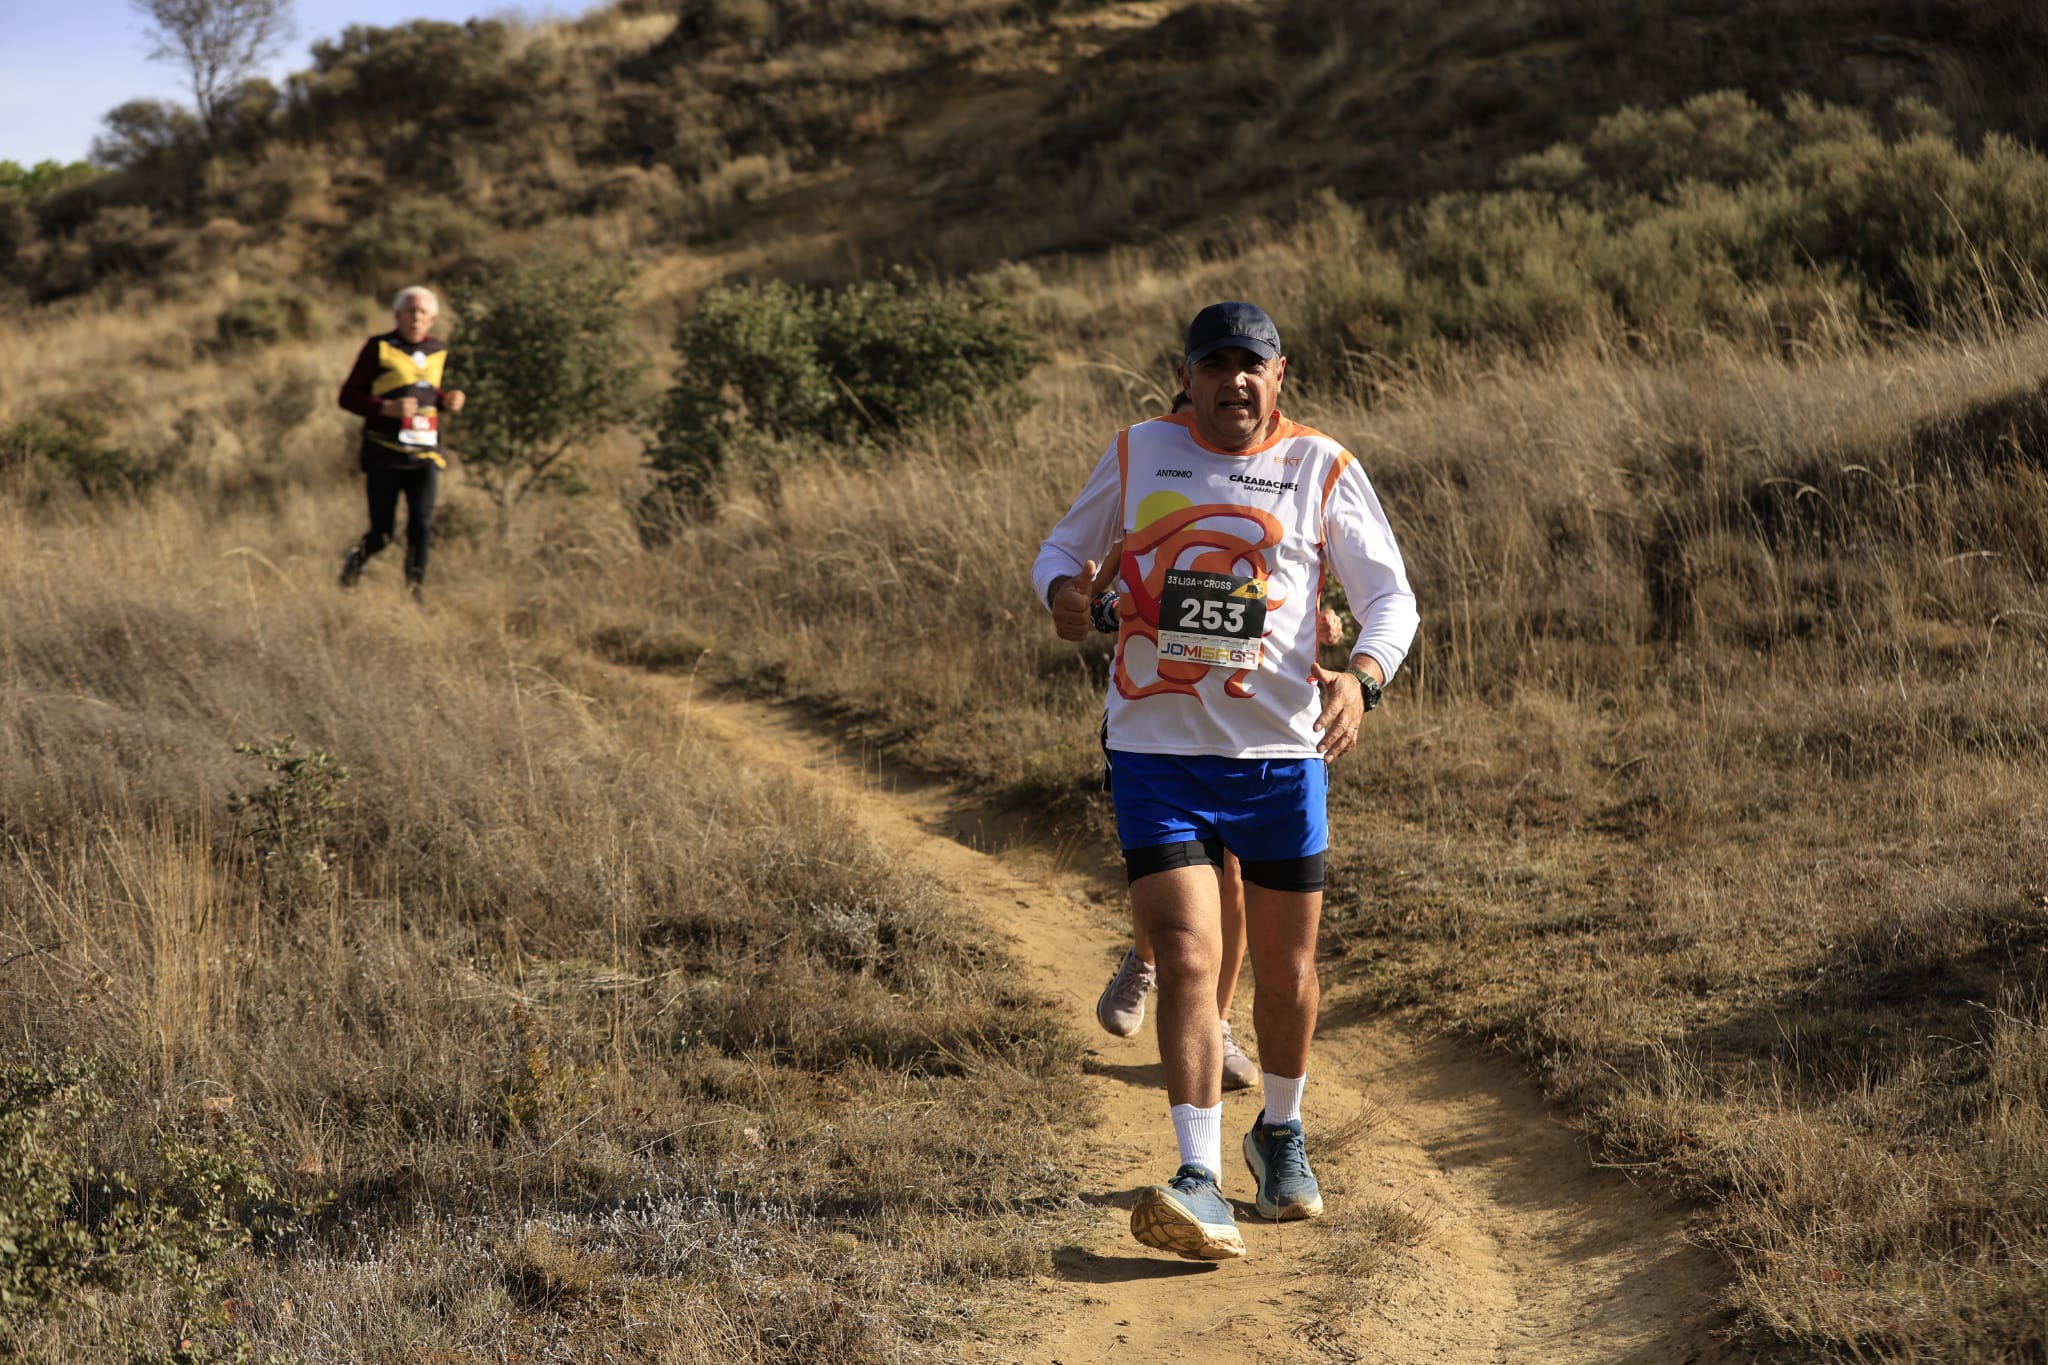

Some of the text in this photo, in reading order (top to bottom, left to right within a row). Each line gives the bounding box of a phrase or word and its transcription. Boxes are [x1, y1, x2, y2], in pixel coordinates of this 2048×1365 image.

[1155, 469, 1193, 479] ANTONIO
[1243, 484, 1283, 496] SALAMANCA
[1178, 576, 1197, 587] LIGA
[1203, 579, 1232, 591] CROSS
[1179, 598, 1246, 633] 253
